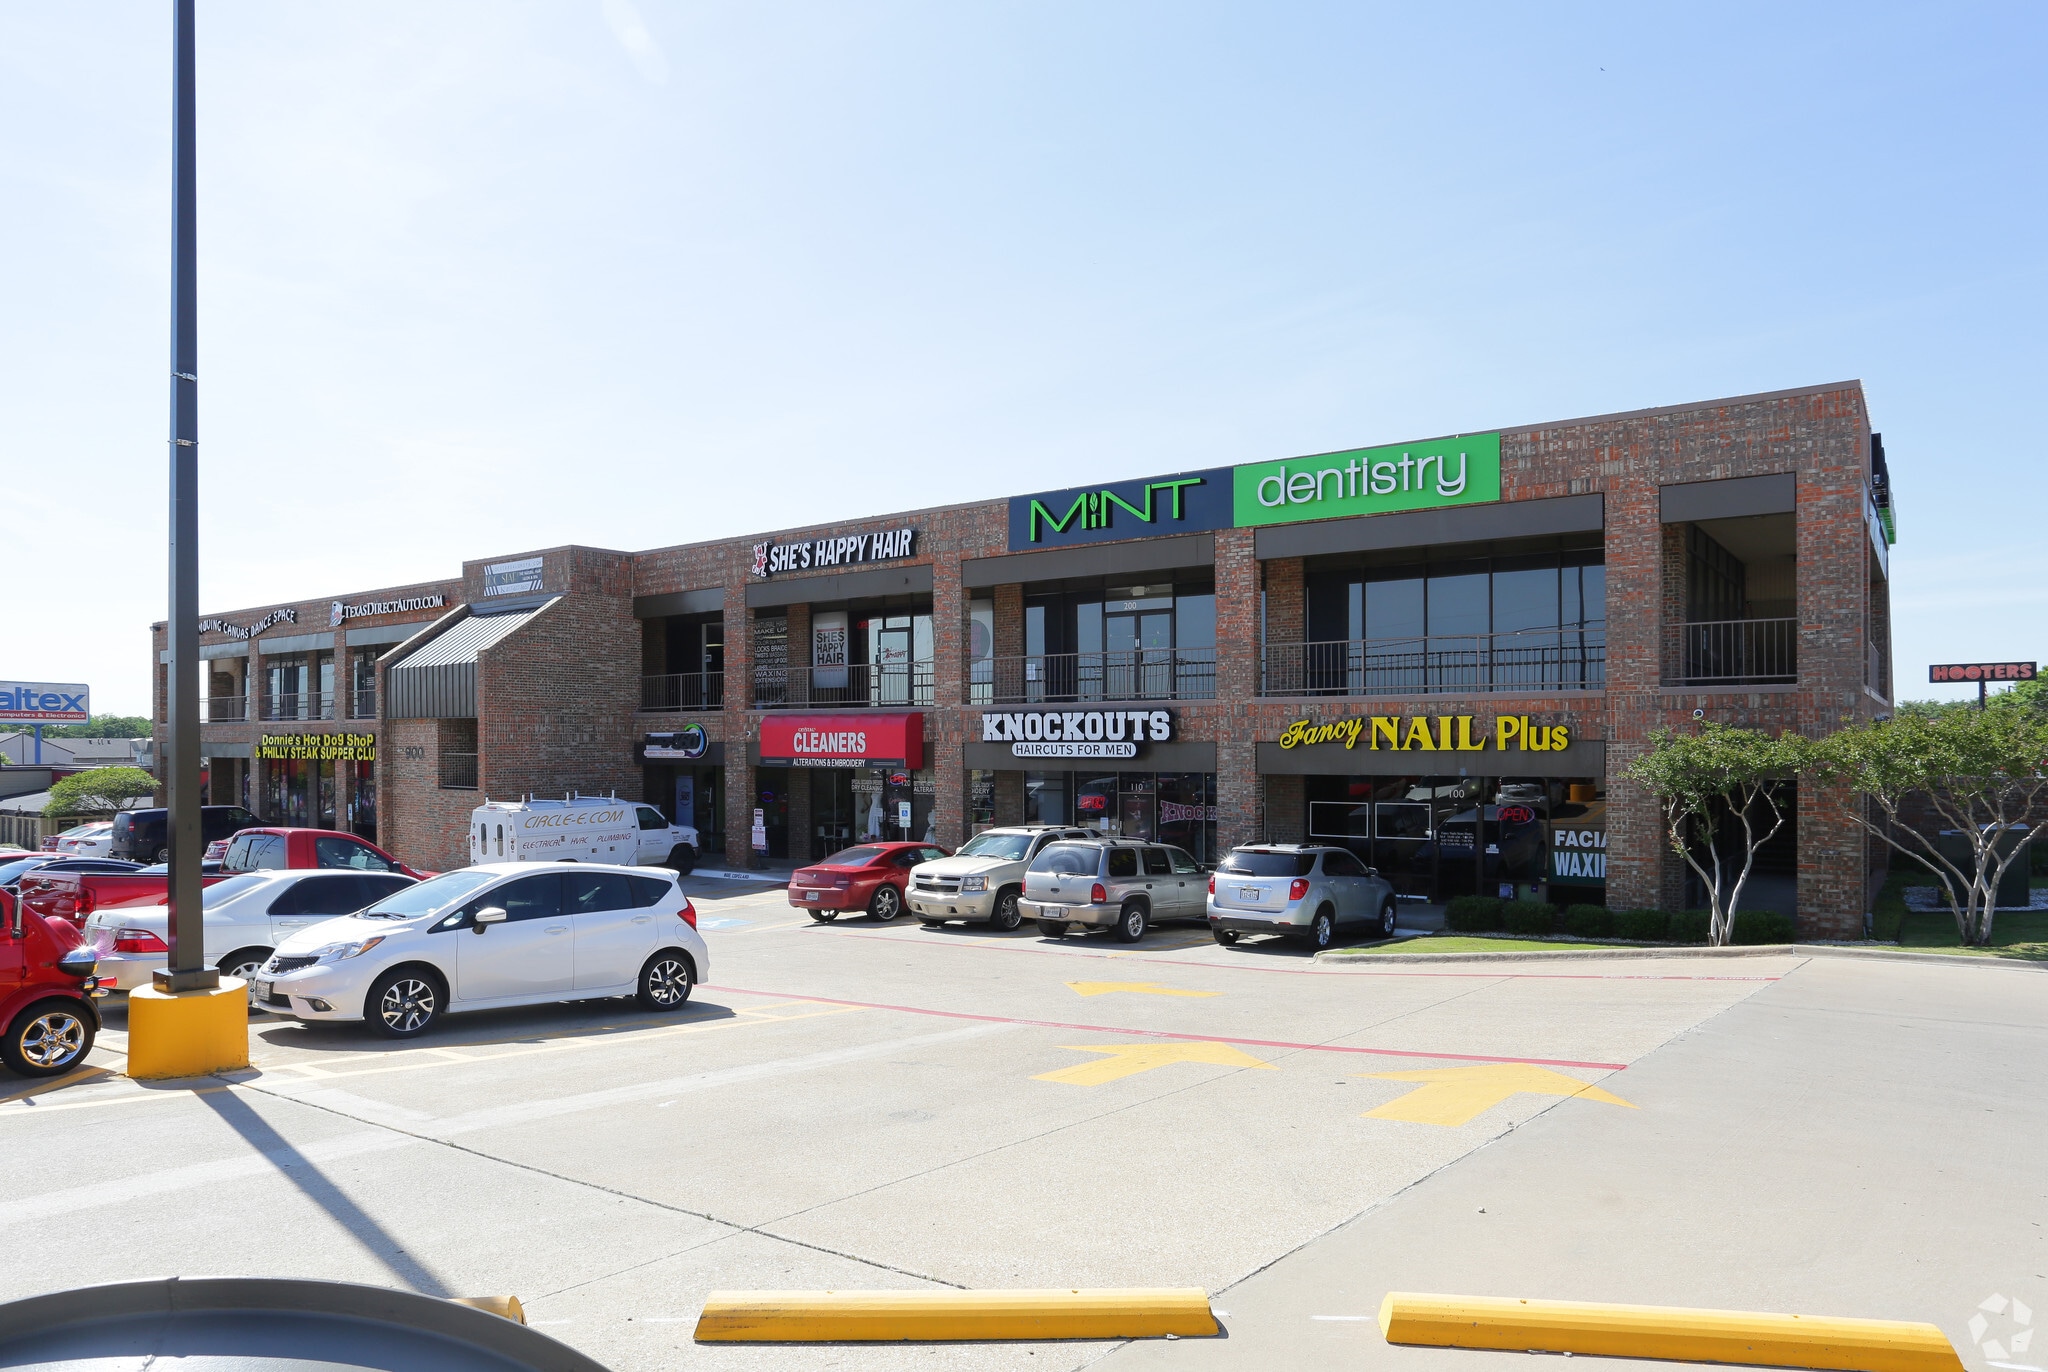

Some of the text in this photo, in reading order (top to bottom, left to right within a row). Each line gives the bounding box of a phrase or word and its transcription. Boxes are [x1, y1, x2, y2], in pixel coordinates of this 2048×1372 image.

[1256, 452, 1467, 508] dentistry
[1029, 476, 1201, 543] MINT
[769, 528, 912, 572] SHE'S HAPPY HAIR
[1123, 601, 1137, 611] 200
[223, 622, 249, 640] CANVAS
[250, 614, 272, 637] DANCE
[273, 608, 295, 624] SPACE
[816, 631, 844, 643] SHES
[816, 642, 844, 654] HAPPY
[817, 653, 844, 665] HAIR
[755, 669, 787, 678] WAXING
[1932, 663, 2032, 681] HOOTERS
[0, 687, 86, 711] altex
[982, 711, 1170, 741] KNOCKOUTS
[262, 733, 374, 747] Donnie's Hot Dog Shop
[1279, 716, 1569, 751] Fancy NAIL Plus
[793, 732, 867, 754] CLEANERS
[1015, 744, 1133, 755] HAIRCUTS FOR MEN
[255, 747, 261, 759] &
[262, 747, 289, 759] PHILLY
[290, 747, 319, 760] STEAK
[320, 747, 355, 761] SUPPER
[405, 746, 424, 760] 900
[792, 758, 866, 768] ALTERATIONS & EMBROIDERY
[1131, 783, 1144, 792] 110
[1449, 789, 1465, 800] 100
[524, 809, 625, 829] CIRCLE-E.COM
[1496, 807, 1531, 822] OPEN
[522, 832, 632, 850] ELECTRICAL HVAC PLUMBING
